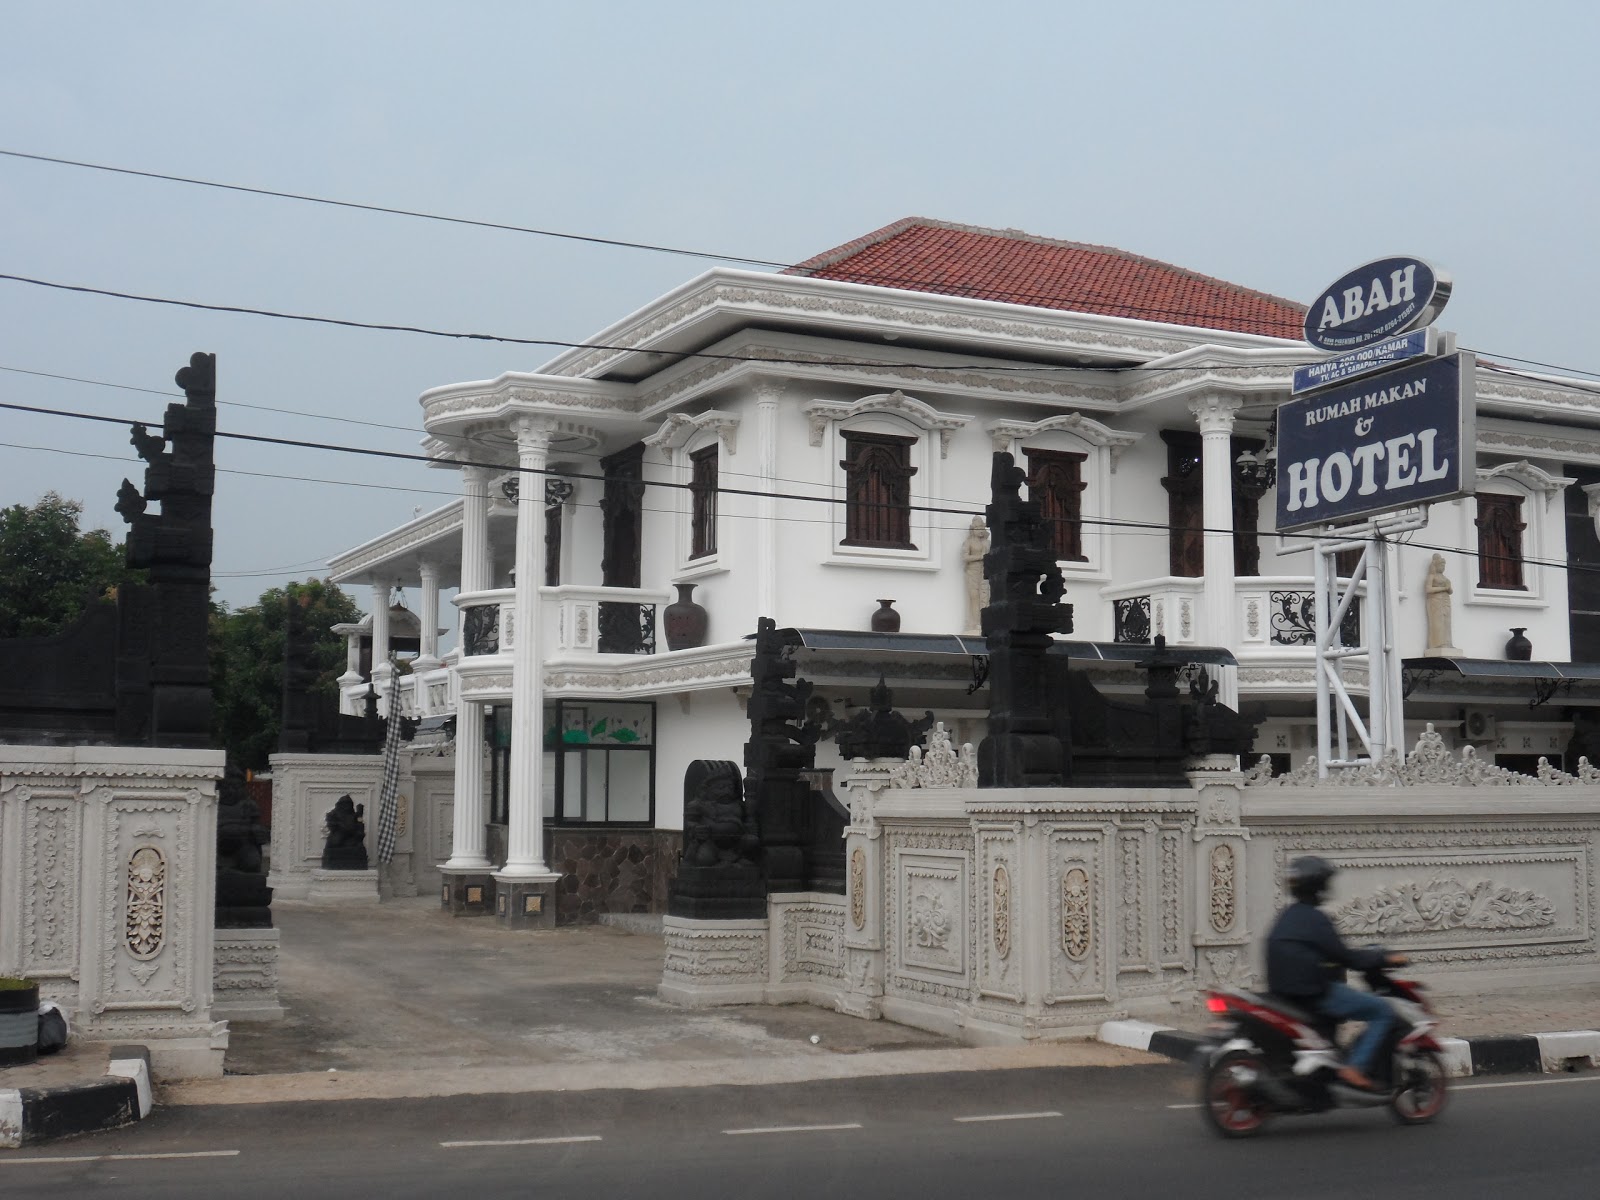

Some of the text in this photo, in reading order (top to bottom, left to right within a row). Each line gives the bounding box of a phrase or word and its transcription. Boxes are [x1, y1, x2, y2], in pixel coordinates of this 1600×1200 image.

[1317, 264, 1416, 332] ABAH
[1308, 361, 1337, 377] HANYA
[1331, 370, 1340, 378] AC
[1341, 368, 1346, 376] &
[1347, 359, 1377, 373] SARAPAN
[1378, 353, 1394, 364] PAGI
[1306, 378, 1427, 426] RUMAH MAKAN
[1354, 416, 1375, 436] &
[1286, 428, 1449, 512] HOTEL
